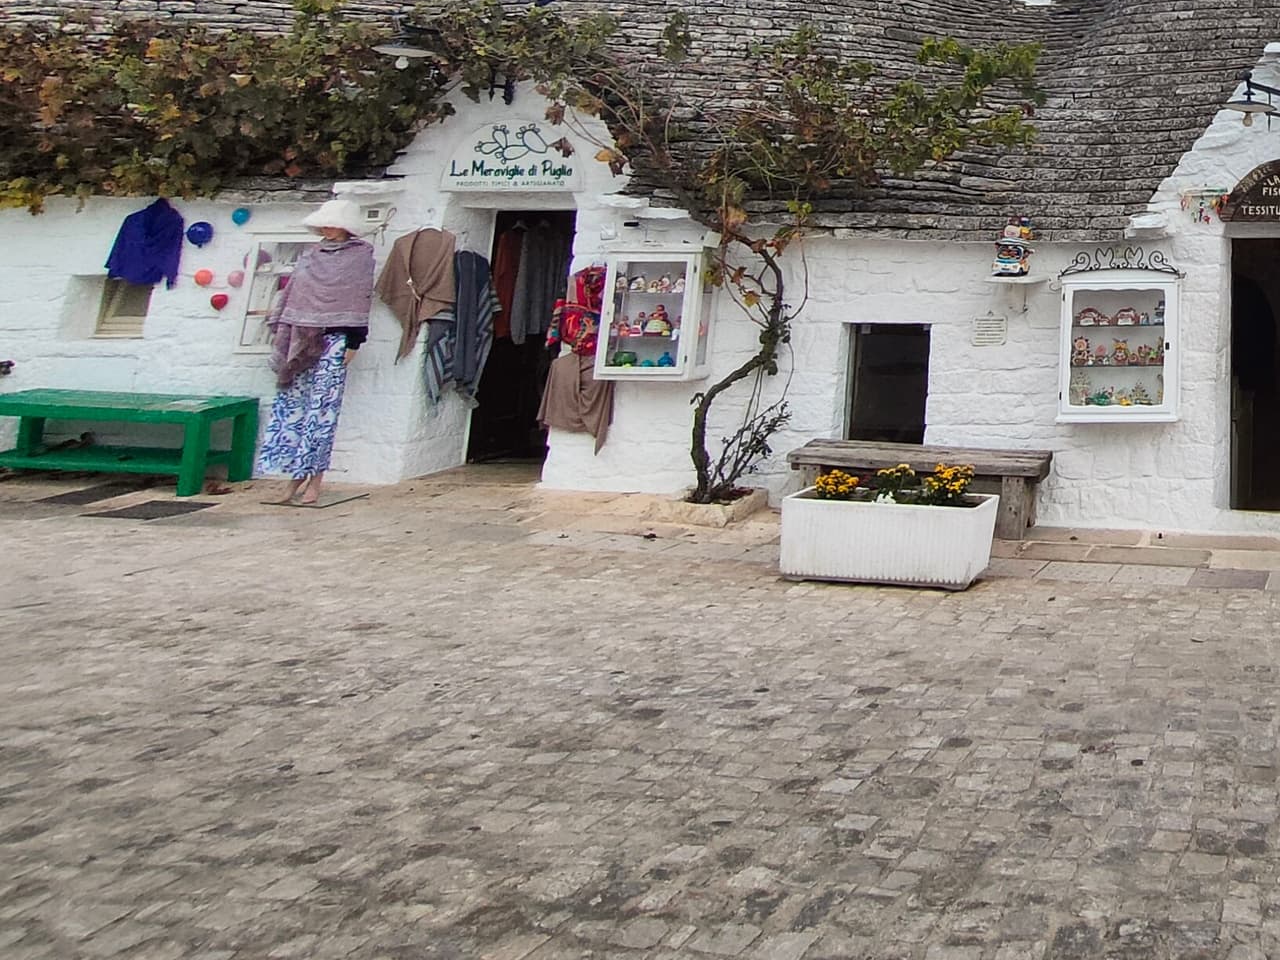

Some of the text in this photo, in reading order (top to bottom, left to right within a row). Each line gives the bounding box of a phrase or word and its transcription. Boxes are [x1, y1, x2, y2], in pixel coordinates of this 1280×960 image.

[450, 159, 573, 180] Le Meraviglie di Puglia
